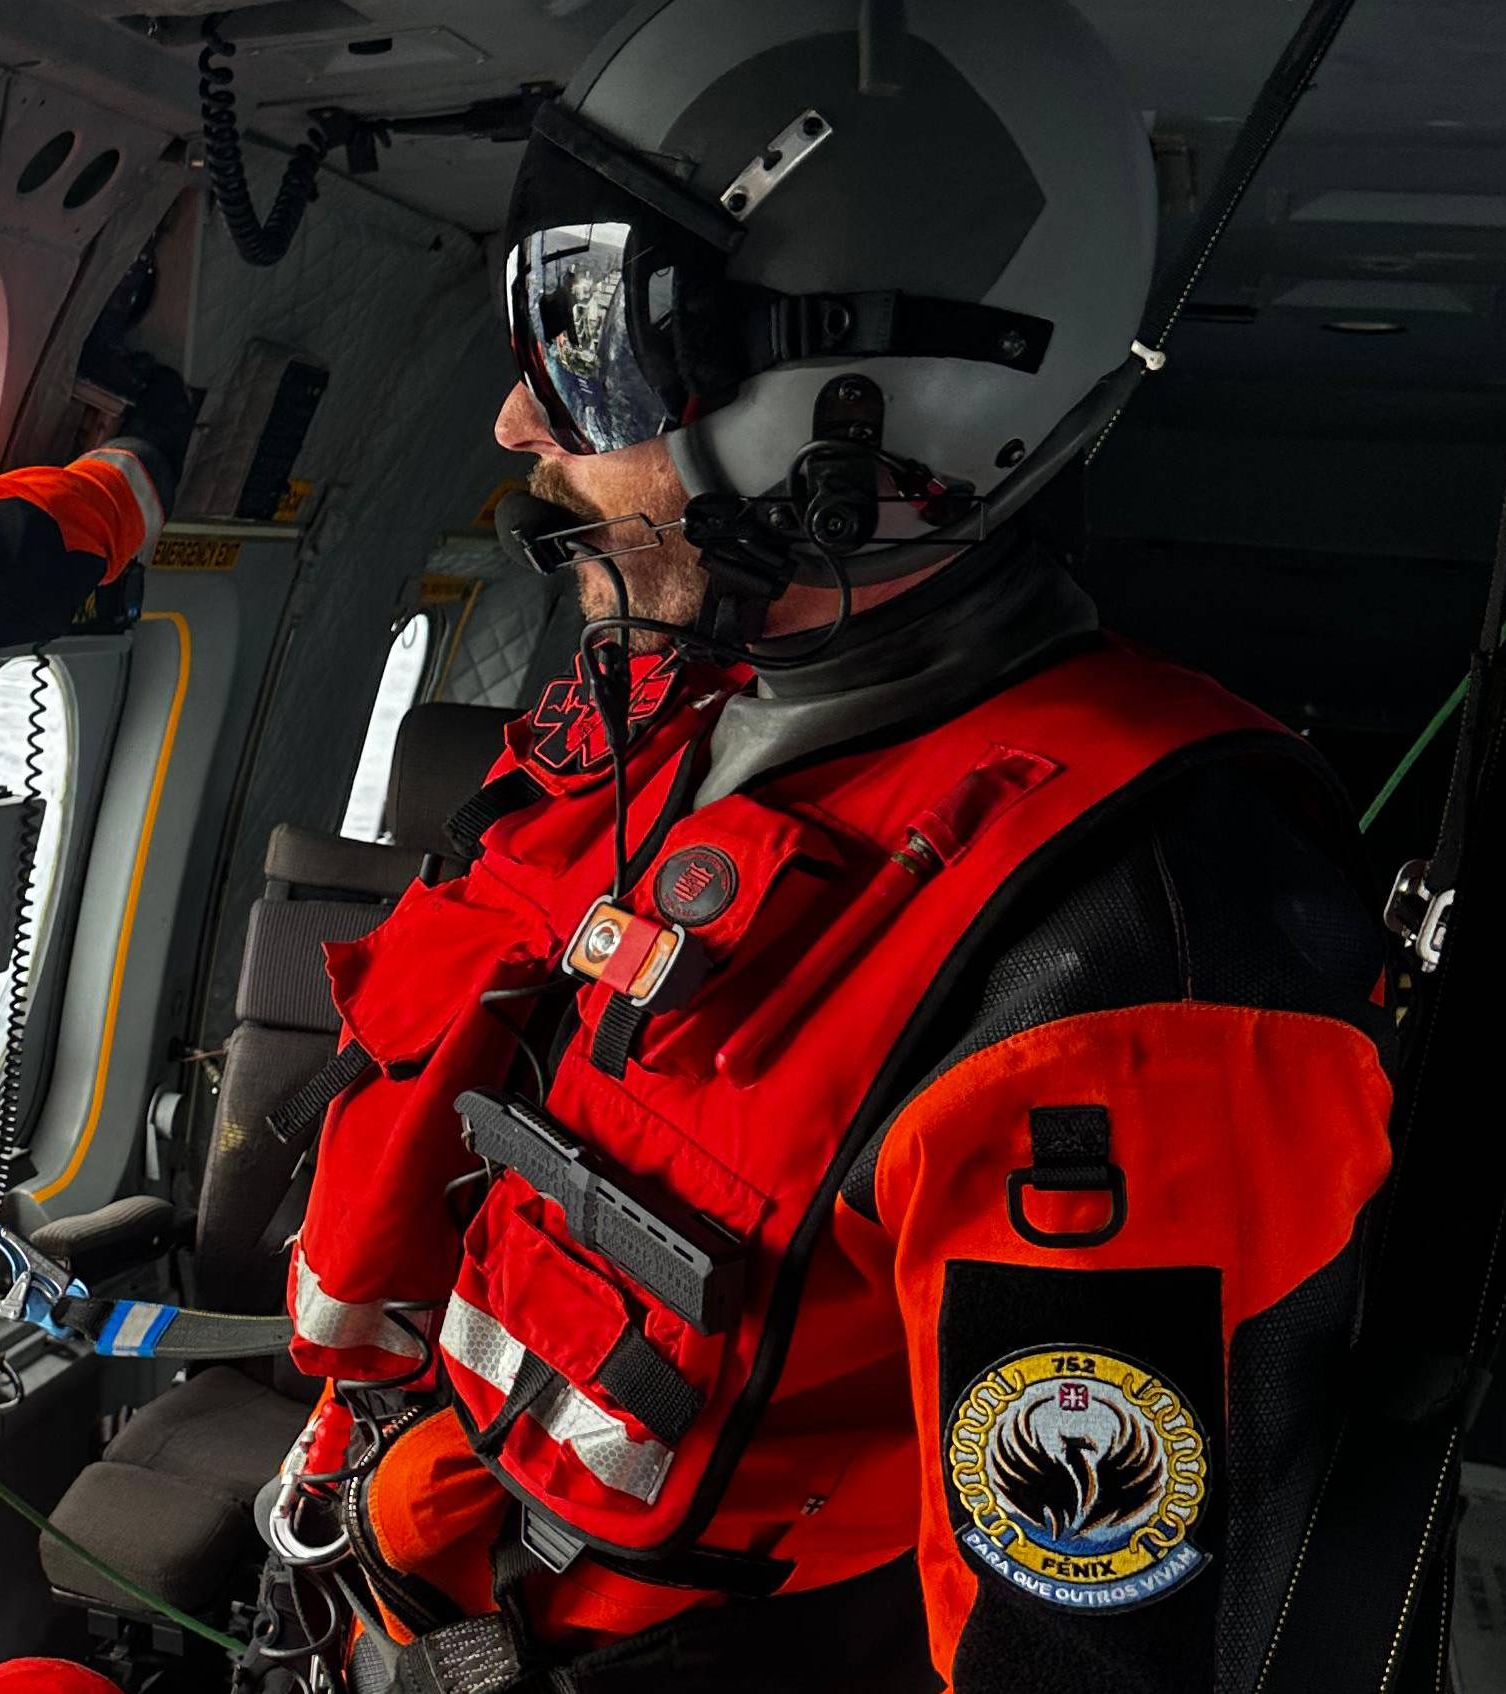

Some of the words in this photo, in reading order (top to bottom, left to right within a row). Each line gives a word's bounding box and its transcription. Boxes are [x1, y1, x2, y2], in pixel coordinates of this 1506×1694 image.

[152, 541, 216, 566] EMERGENCY
[215, 543, 241, 567] EXIT
[1051, 1356, 1096, 1374] 752
[965, 1532, 1010, 1574] PARA
[1012, 1569, 1053, 1597] QUE
[1054, 1582, 1140, 1605] OUTROS
[1138, 1546, 1199, 1593] VIVAM
[1040, 1555, 1118, 1578] FÉNIX
